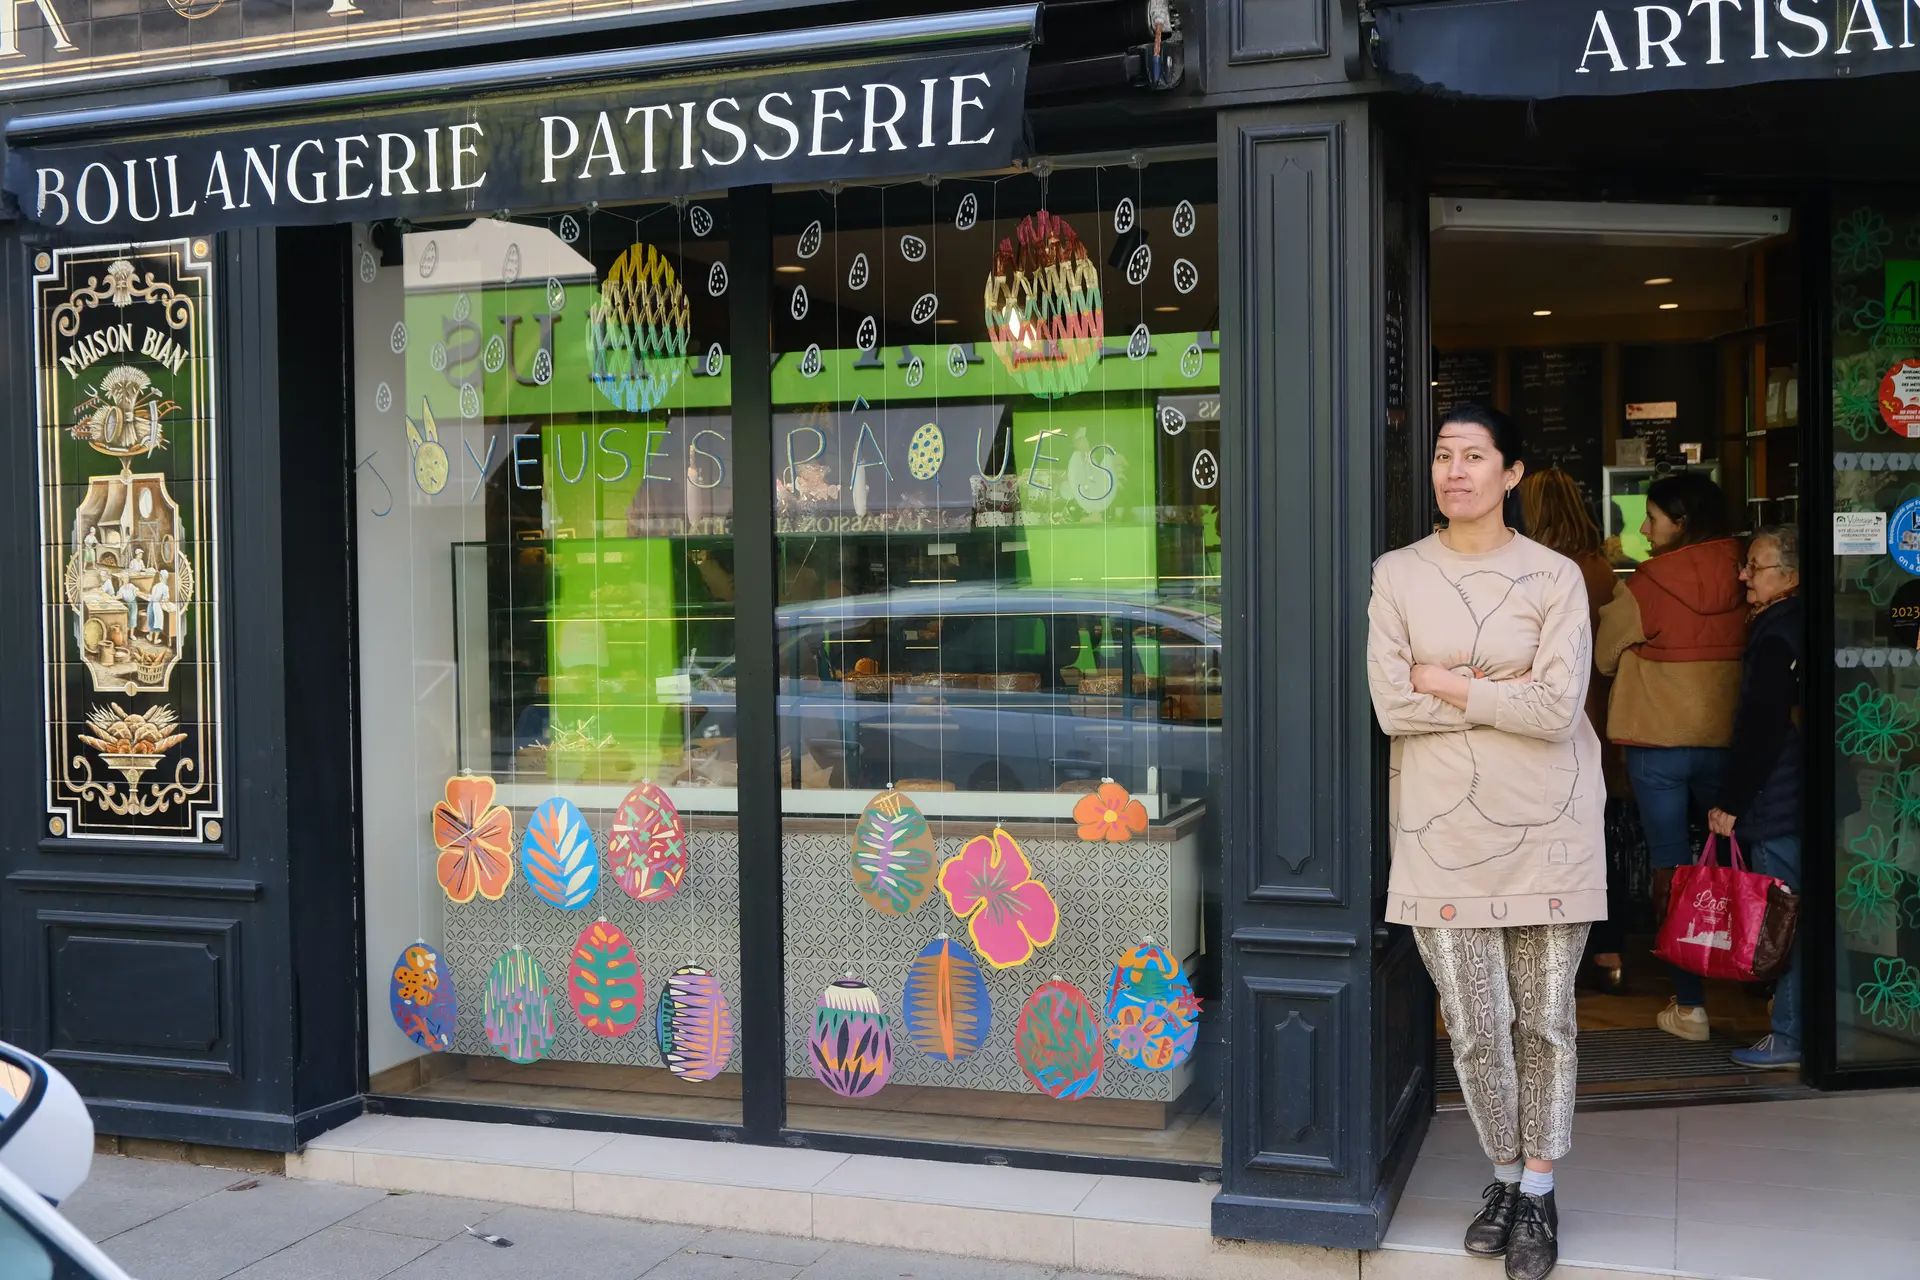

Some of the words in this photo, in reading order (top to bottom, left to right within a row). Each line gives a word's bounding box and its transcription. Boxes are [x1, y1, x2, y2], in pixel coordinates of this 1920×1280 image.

[35, 122, 487, 227] BOULANGERIE
[540, 72, 996, 184] PATISSERIE
[59, 323, 135, 380] MAISON
[140, 326, 190, 377] BIAN
[1891, 606, 1920, 619] 2023
